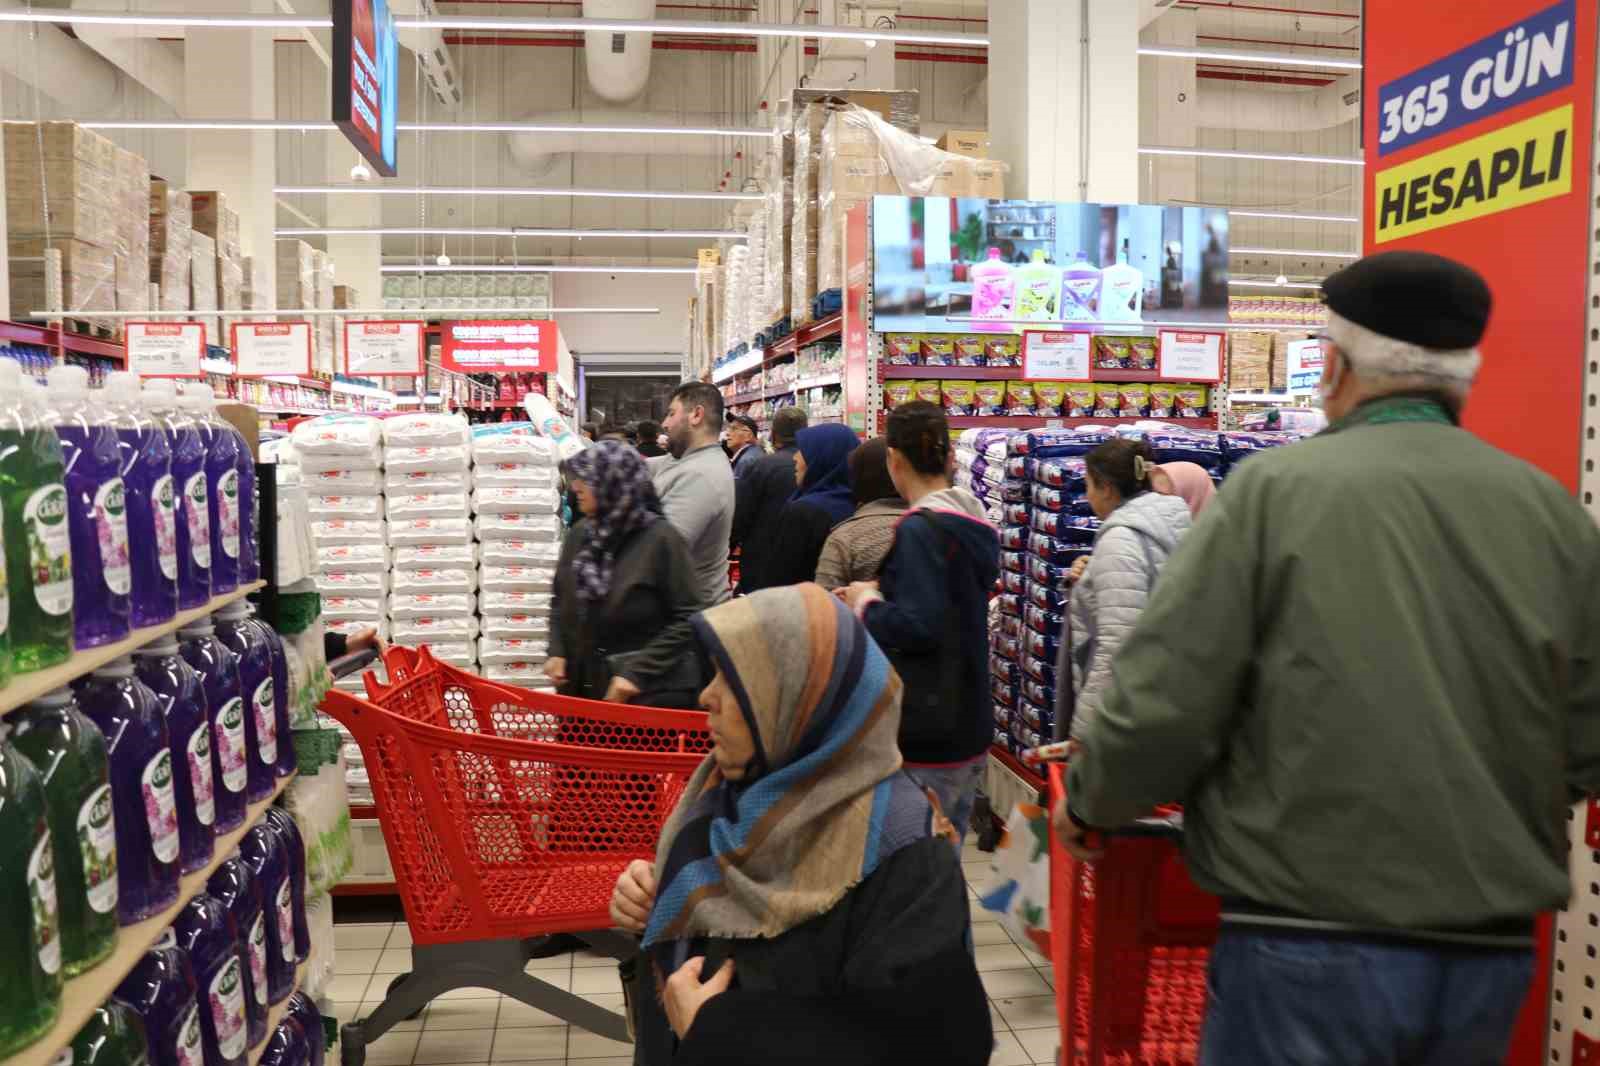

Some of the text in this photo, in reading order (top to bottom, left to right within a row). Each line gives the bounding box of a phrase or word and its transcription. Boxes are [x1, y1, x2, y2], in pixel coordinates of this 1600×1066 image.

[1379, 20, 1569, 144] 365 GÜN
[1379, 128, 1567, 230] HESAPLI
